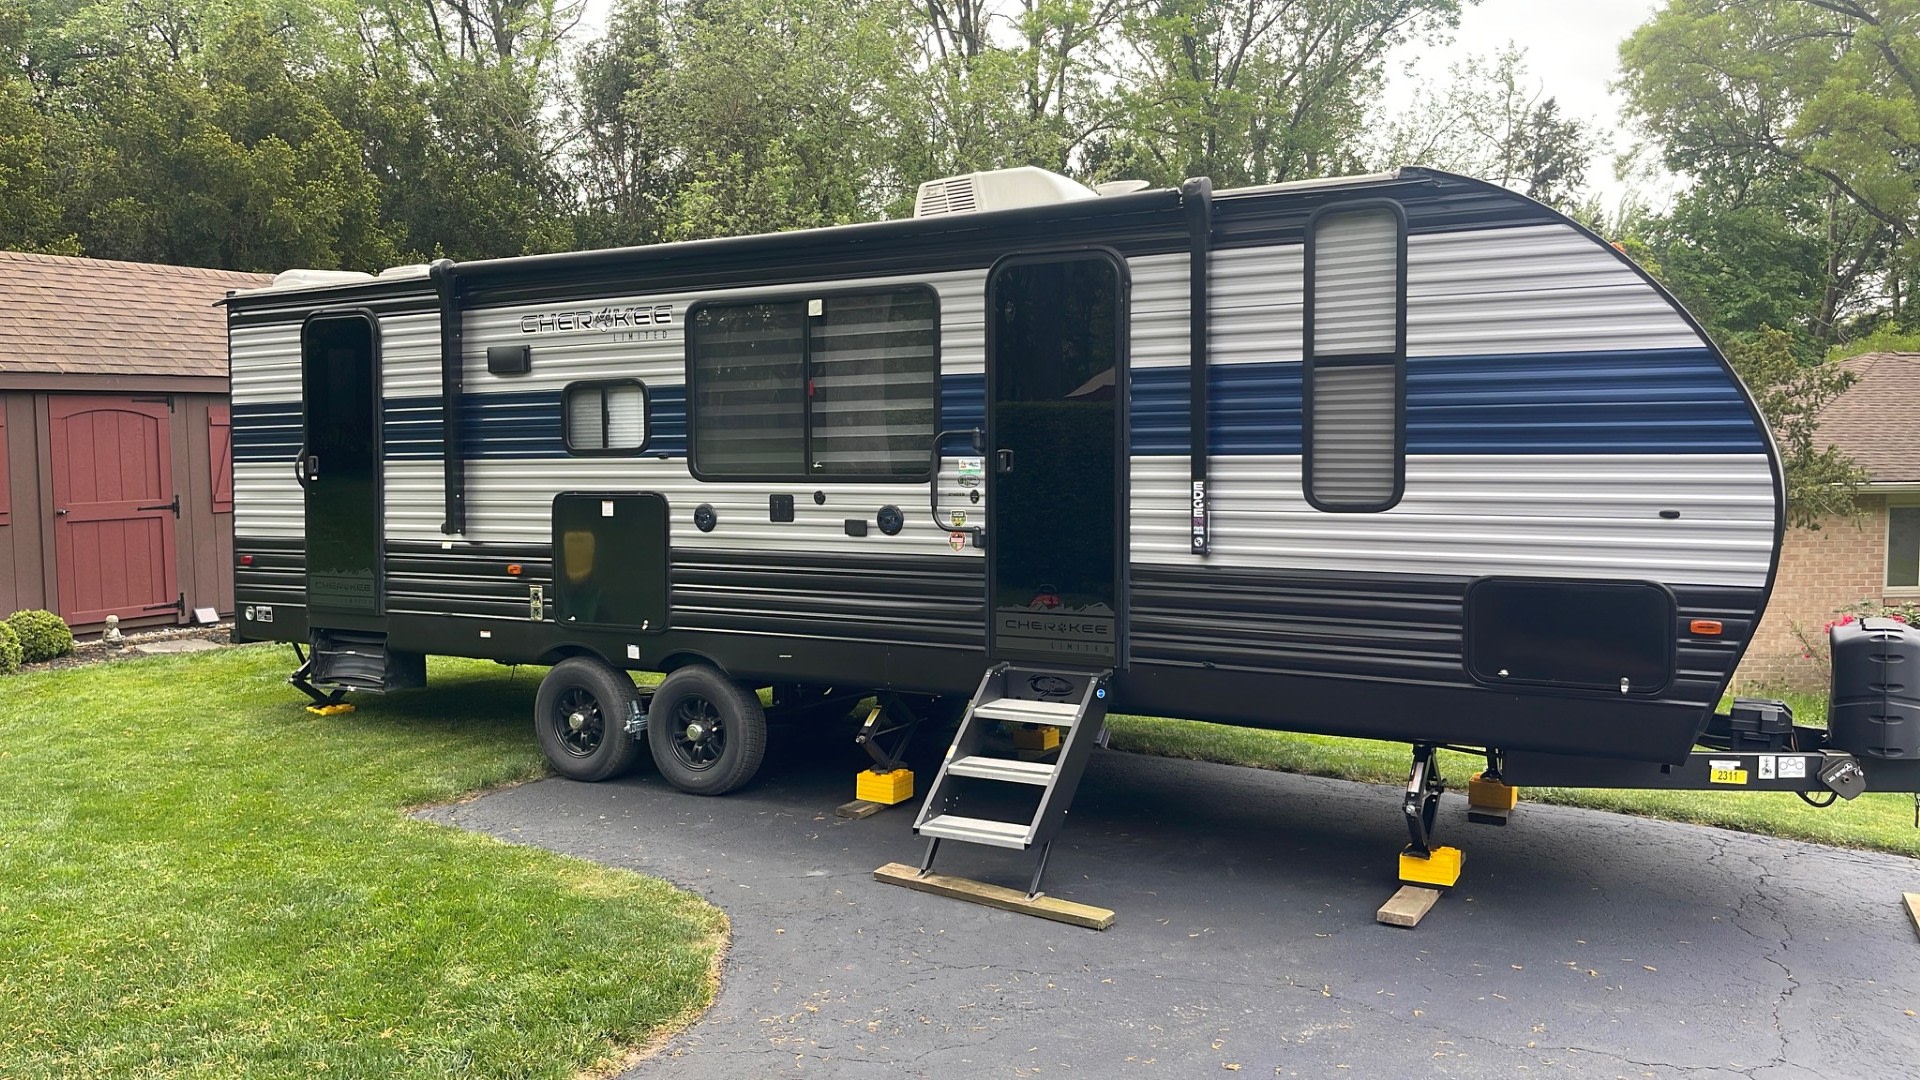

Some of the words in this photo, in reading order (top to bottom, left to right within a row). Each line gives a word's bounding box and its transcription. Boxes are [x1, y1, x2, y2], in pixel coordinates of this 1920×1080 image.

[613, 330, 668, 342] LIMITED
[1193, 481, 1204, 517] EDGE
[1051, 642, 1109, 653] LIMITED
[1717, 770, 1738, 781] 2311
